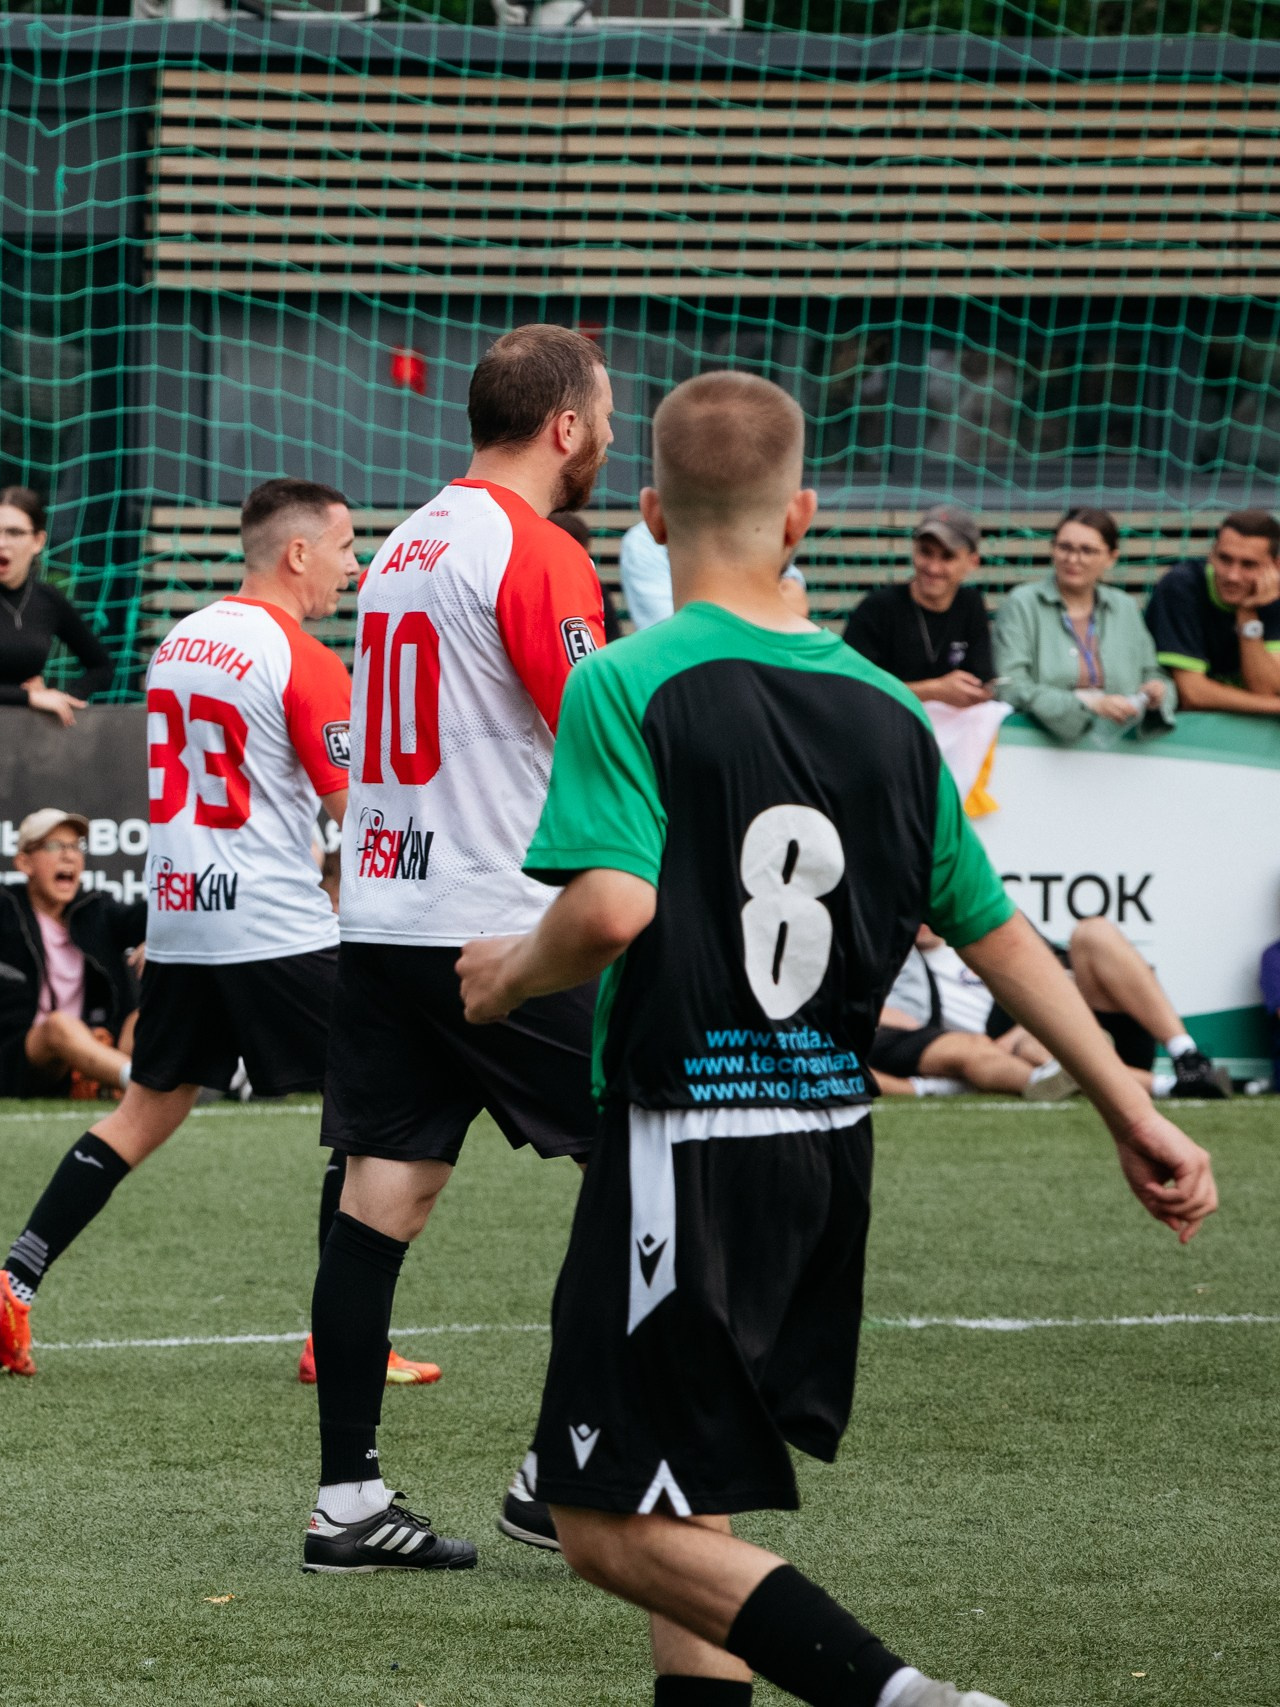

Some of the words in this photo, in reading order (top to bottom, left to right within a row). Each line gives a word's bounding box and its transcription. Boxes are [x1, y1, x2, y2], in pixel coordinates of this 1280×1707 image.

[380, 539, 451, 574] АРЧИ
[155, 637, 253, 681] БЛОХИН
[361, 611, 441, 785] 10
[147, 688, 250, 829] 33
[740, 804, 845, 1020] 8
